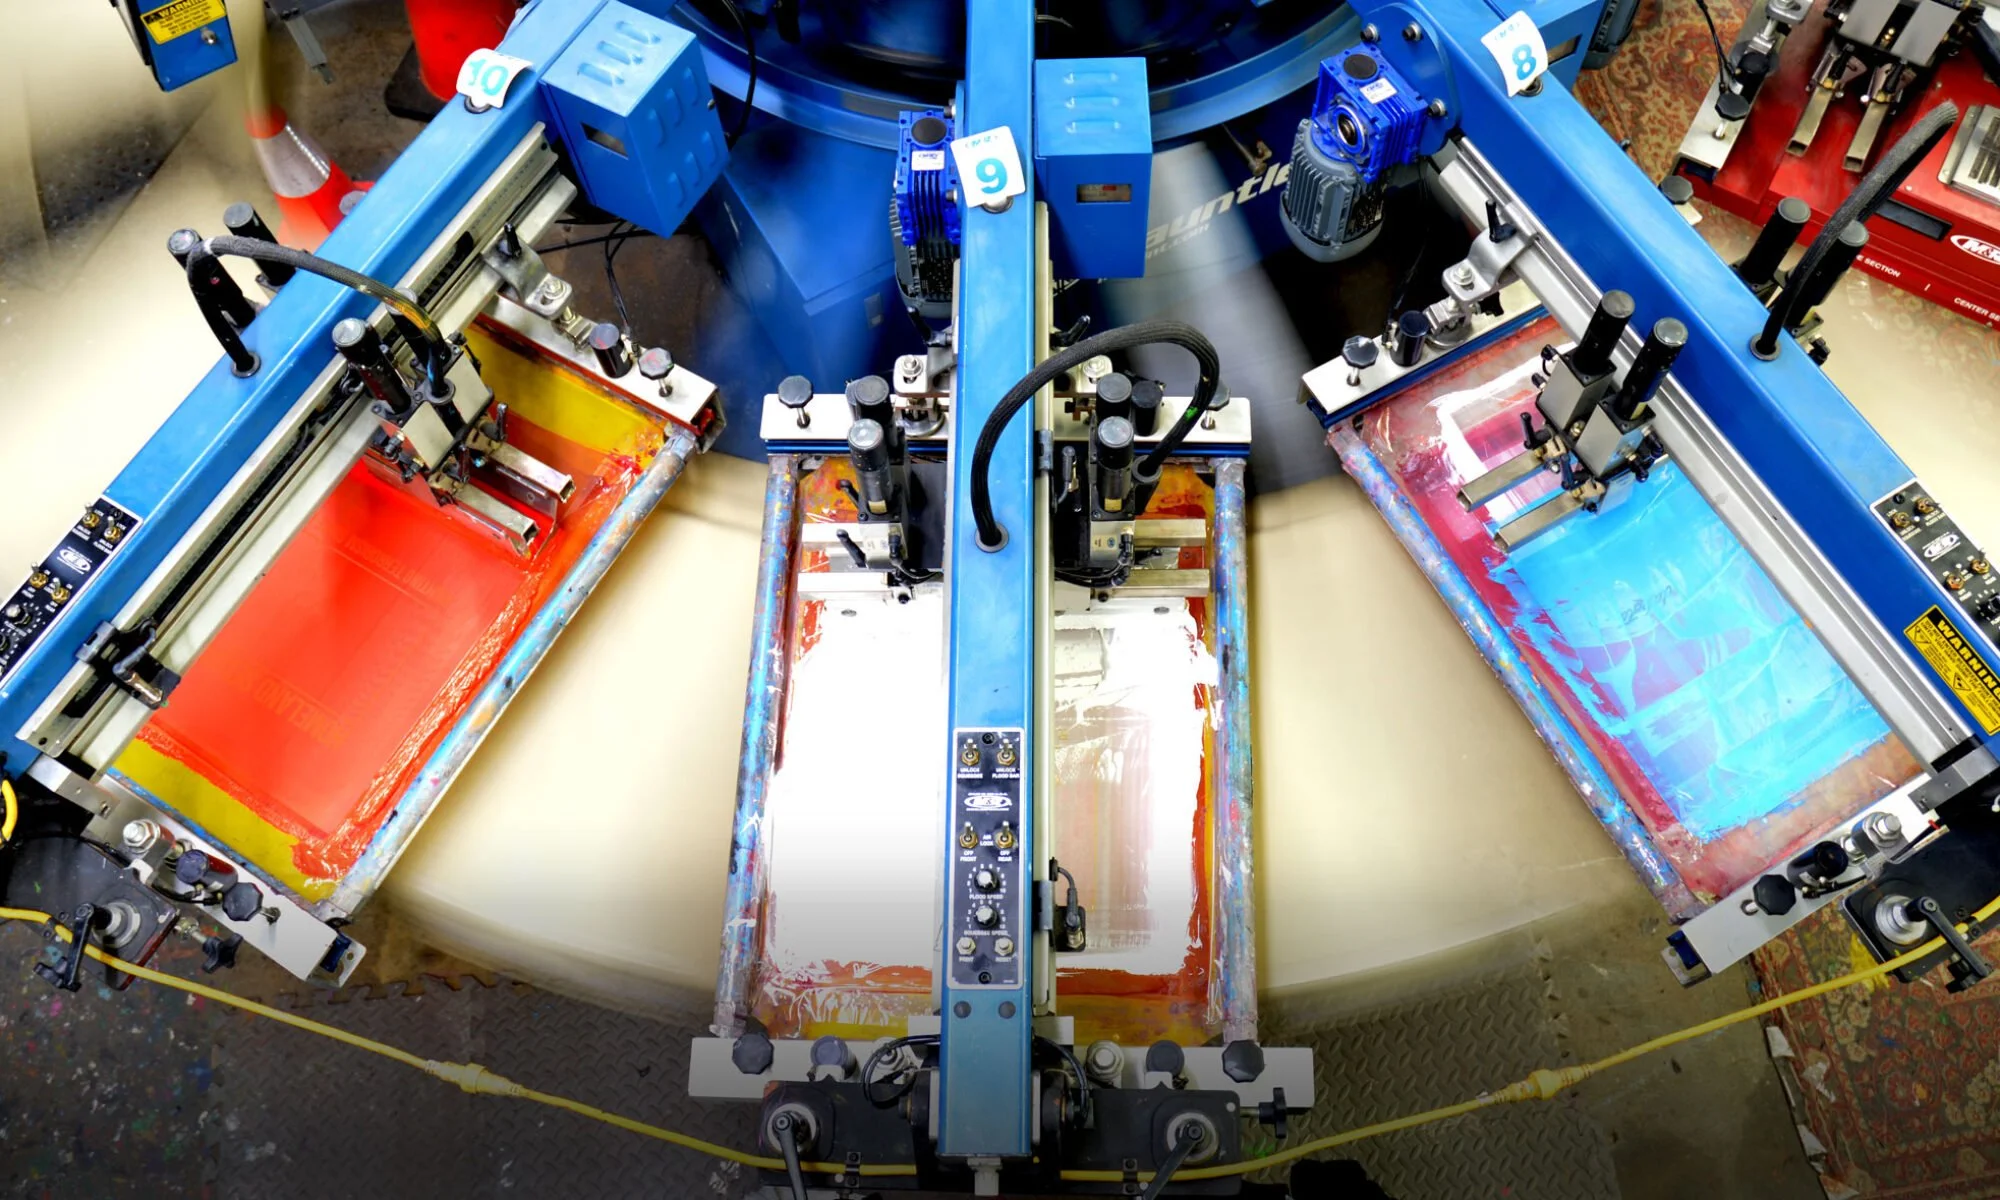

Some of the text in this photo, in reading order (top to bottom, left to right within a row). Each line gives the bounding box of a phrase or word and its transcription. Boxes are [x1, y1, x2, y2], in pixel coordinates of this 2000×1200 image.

[158, 0, 206, 17] WARNI
[467, 59, 508, 96] 10
[1512, 44, 1537, 80] 8
[975, 158, 1008, 194] 9
[1146, 162, 1290, 241] auntle
[1864, 258, 1901, 277] SECTION
[1954, 297, 1989, 317] CENTER
